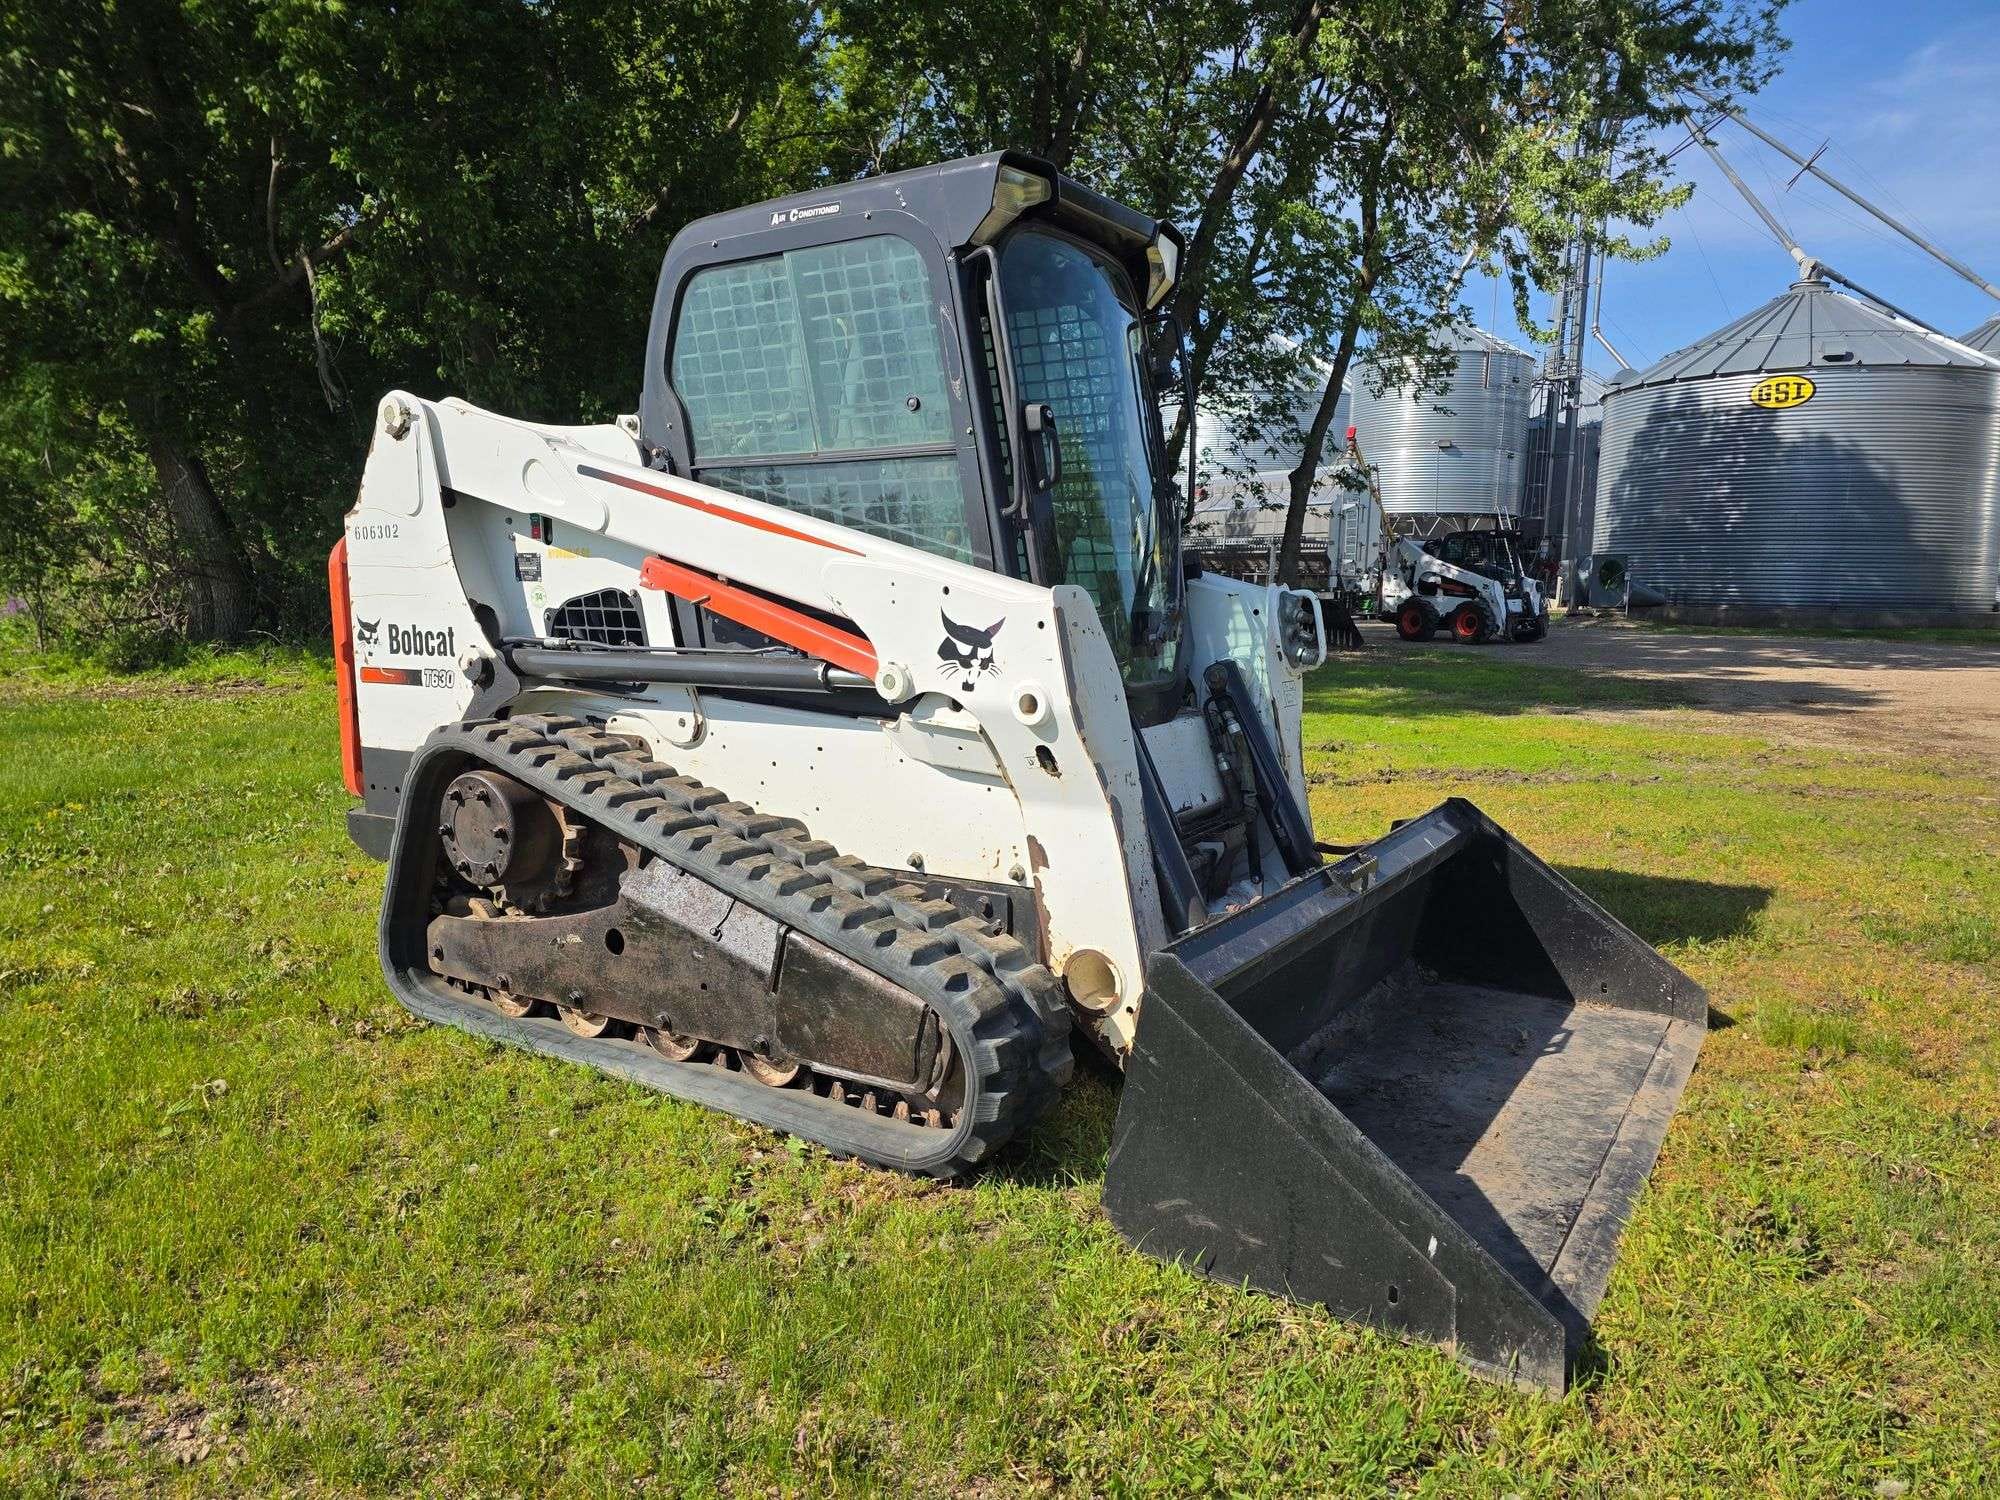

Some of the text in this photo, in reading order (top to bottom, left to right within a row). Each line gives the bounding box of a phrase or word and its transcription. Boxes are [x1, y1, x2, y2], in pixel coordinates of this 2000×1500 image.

[1758, 382, 1806, 403] GSI
[354, 524, 399, 540] 606302
[388, 623, 456, 657] Bobcat
[423, 668, 455, 689] T630
